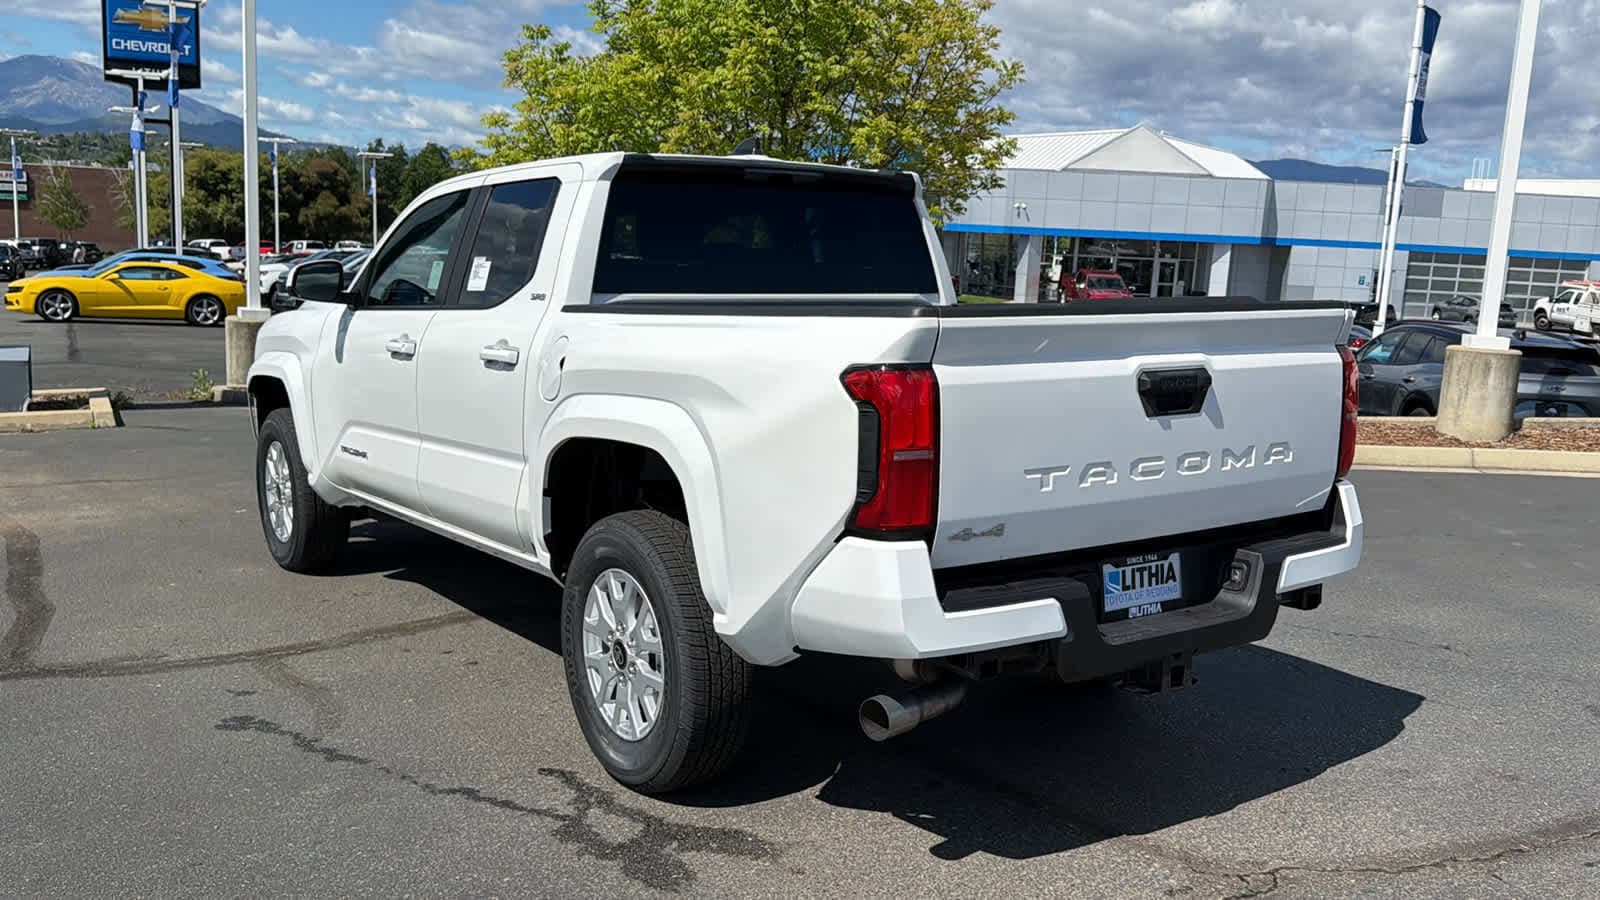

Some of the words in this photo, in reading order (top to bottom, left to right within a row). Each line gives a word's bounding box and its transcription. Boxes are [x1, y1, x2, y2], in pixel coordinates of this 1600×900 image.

[112, 38, 192, 56] CHEVROLT
[1024, 441, 1293, 492] TACOMA
[1121, 561, 1177, 592] LITHIA
[1105, 592, 1133, 607] TOYOTA
[1136, 602, 1162, 617] LITHIA
